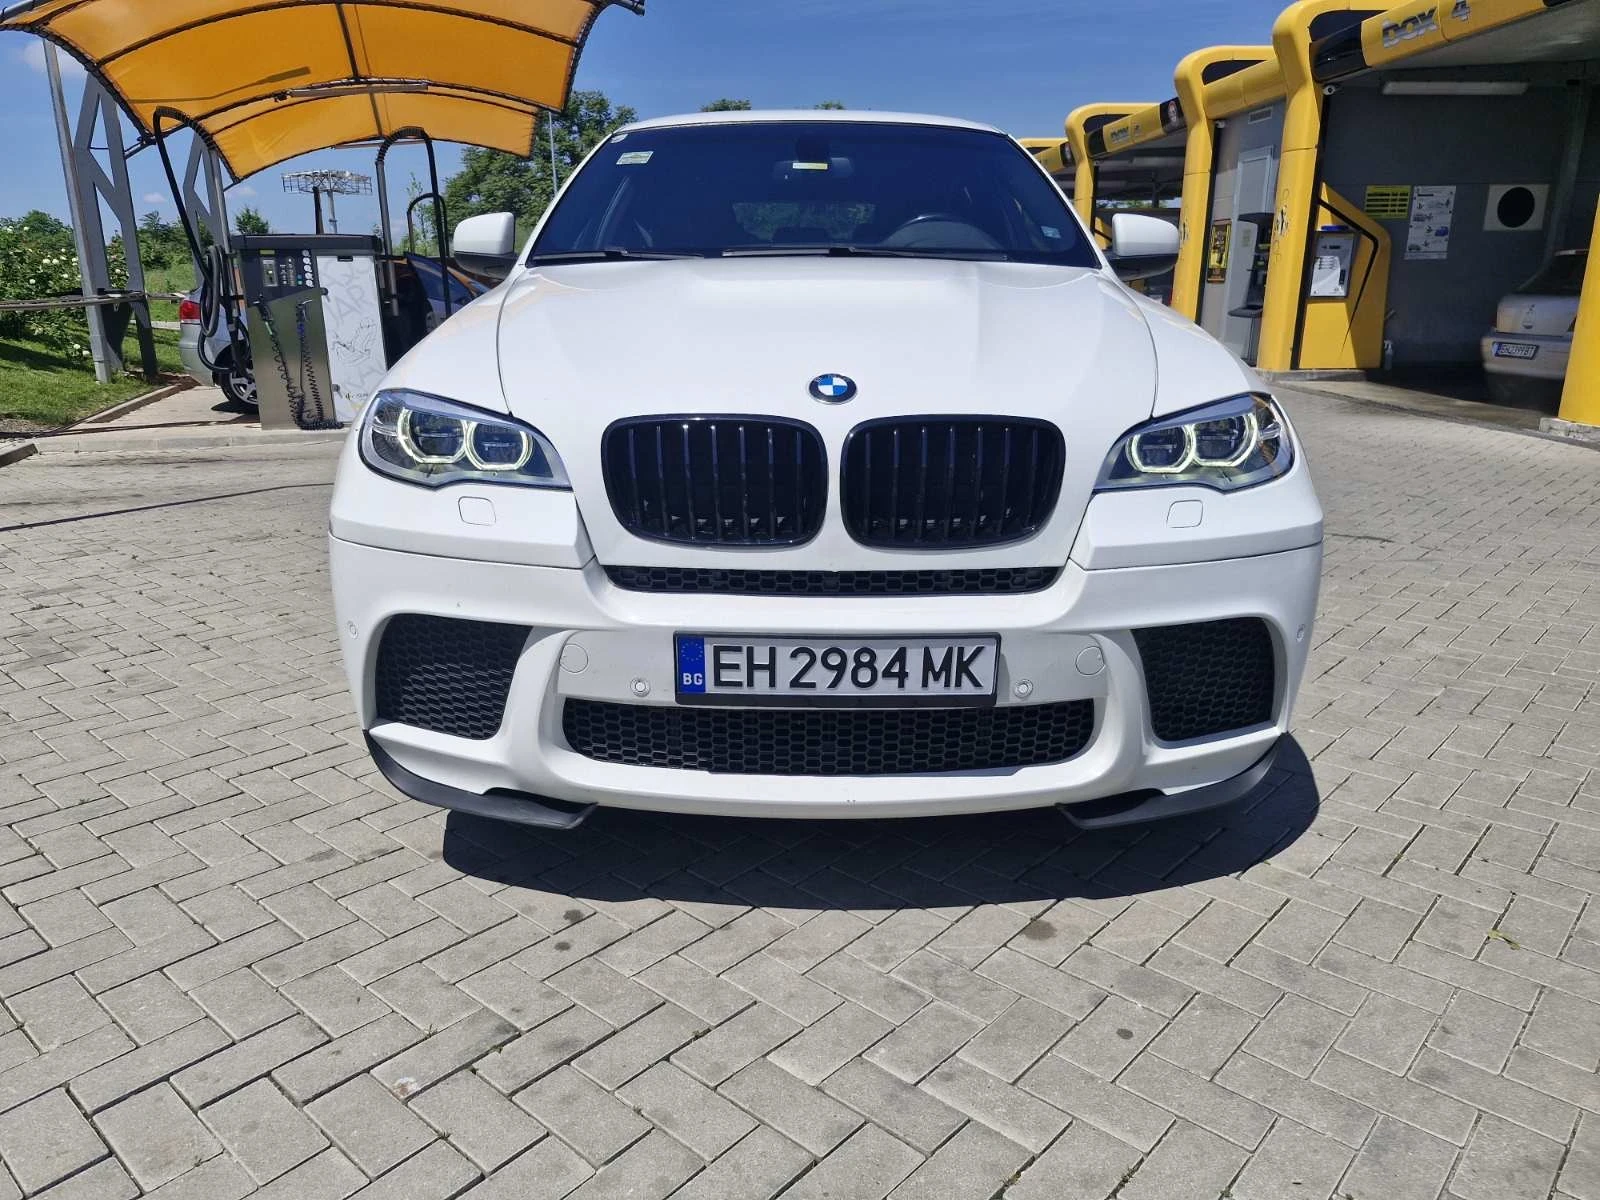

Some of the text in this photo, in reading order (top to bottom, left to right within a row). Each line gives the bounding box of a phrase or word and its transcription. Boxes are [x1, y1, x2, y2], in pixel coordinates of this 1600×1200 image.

[682, 672, 703, 686] BG
[713, 645, 985, 688] EH 2984 MK
